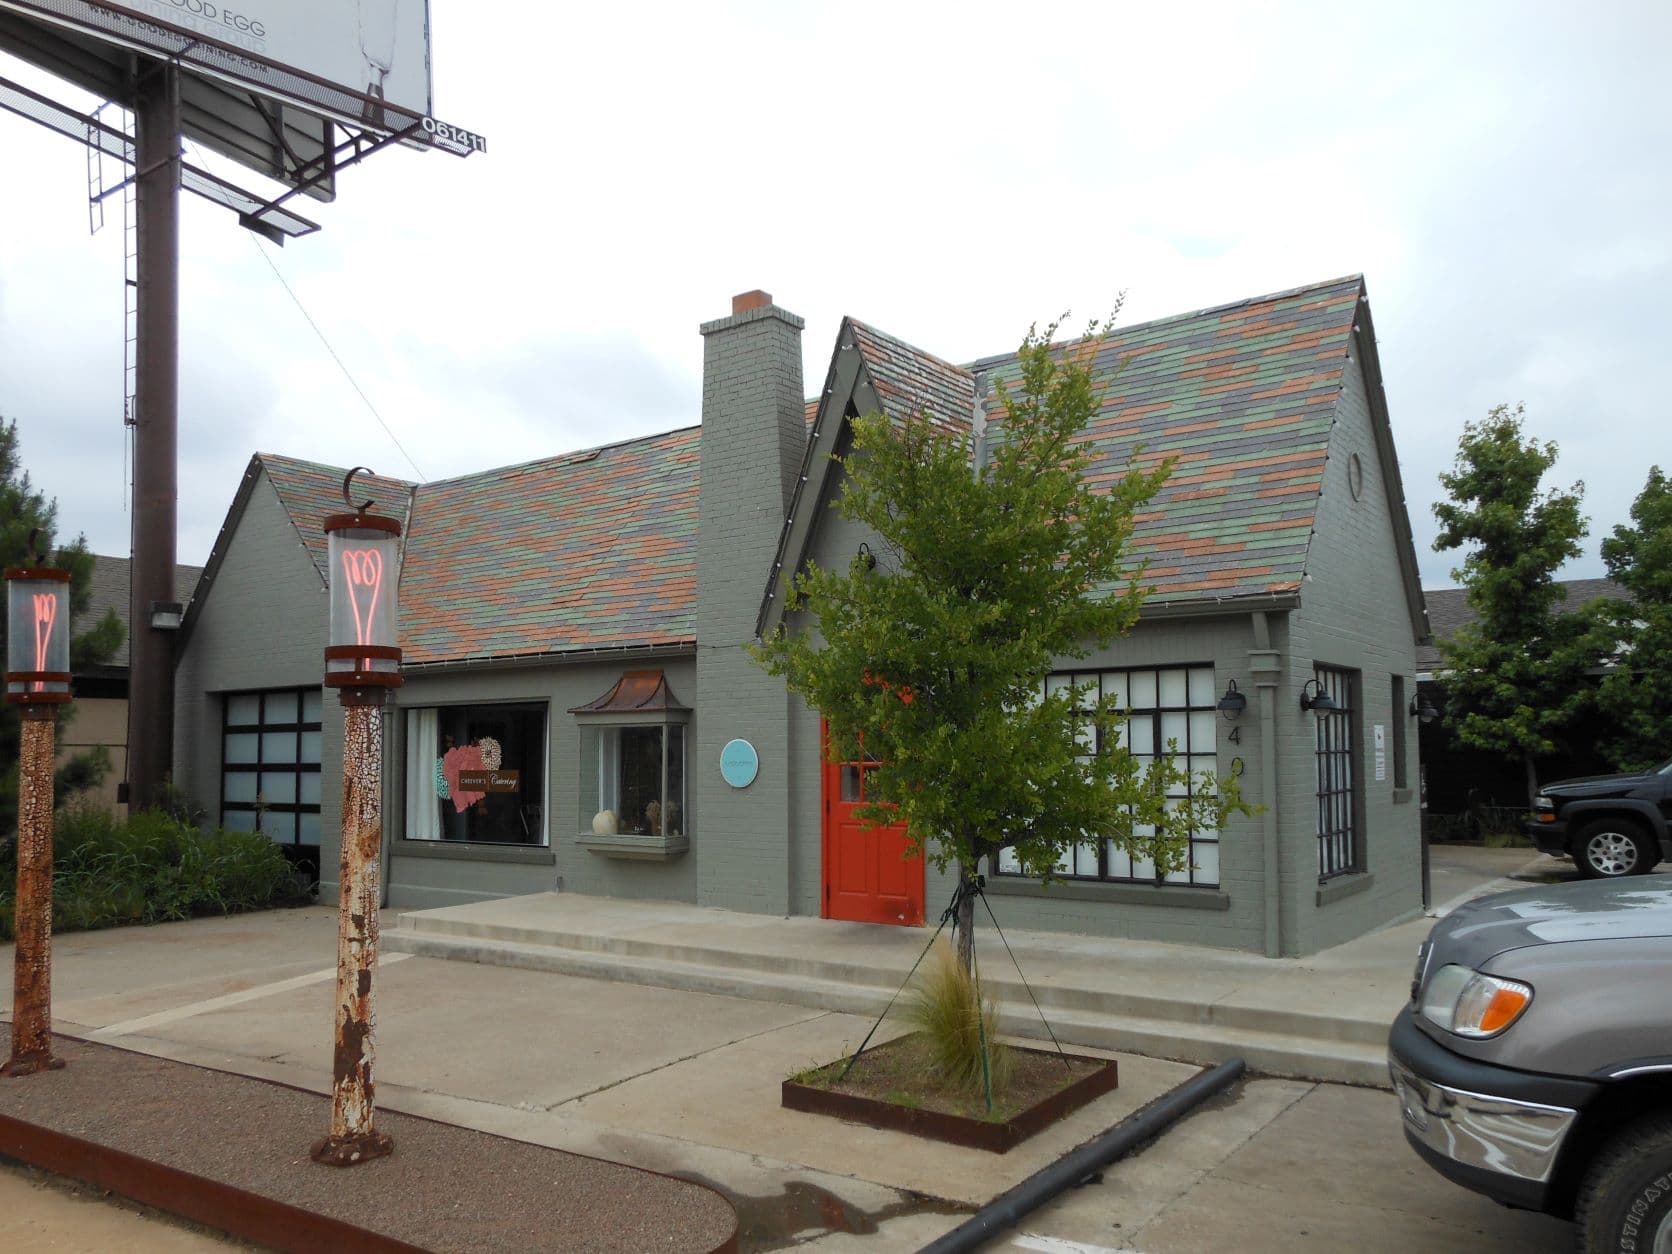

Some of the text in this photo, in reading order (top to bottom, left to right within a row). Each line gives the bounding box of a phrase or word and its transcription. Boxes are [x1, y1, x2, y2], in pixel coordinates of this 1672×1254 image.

[222, 9, 267, 37] EGG
[422, 116, 486, 153] 061411
[1621, 1172, 1672, 1254] STINAT
